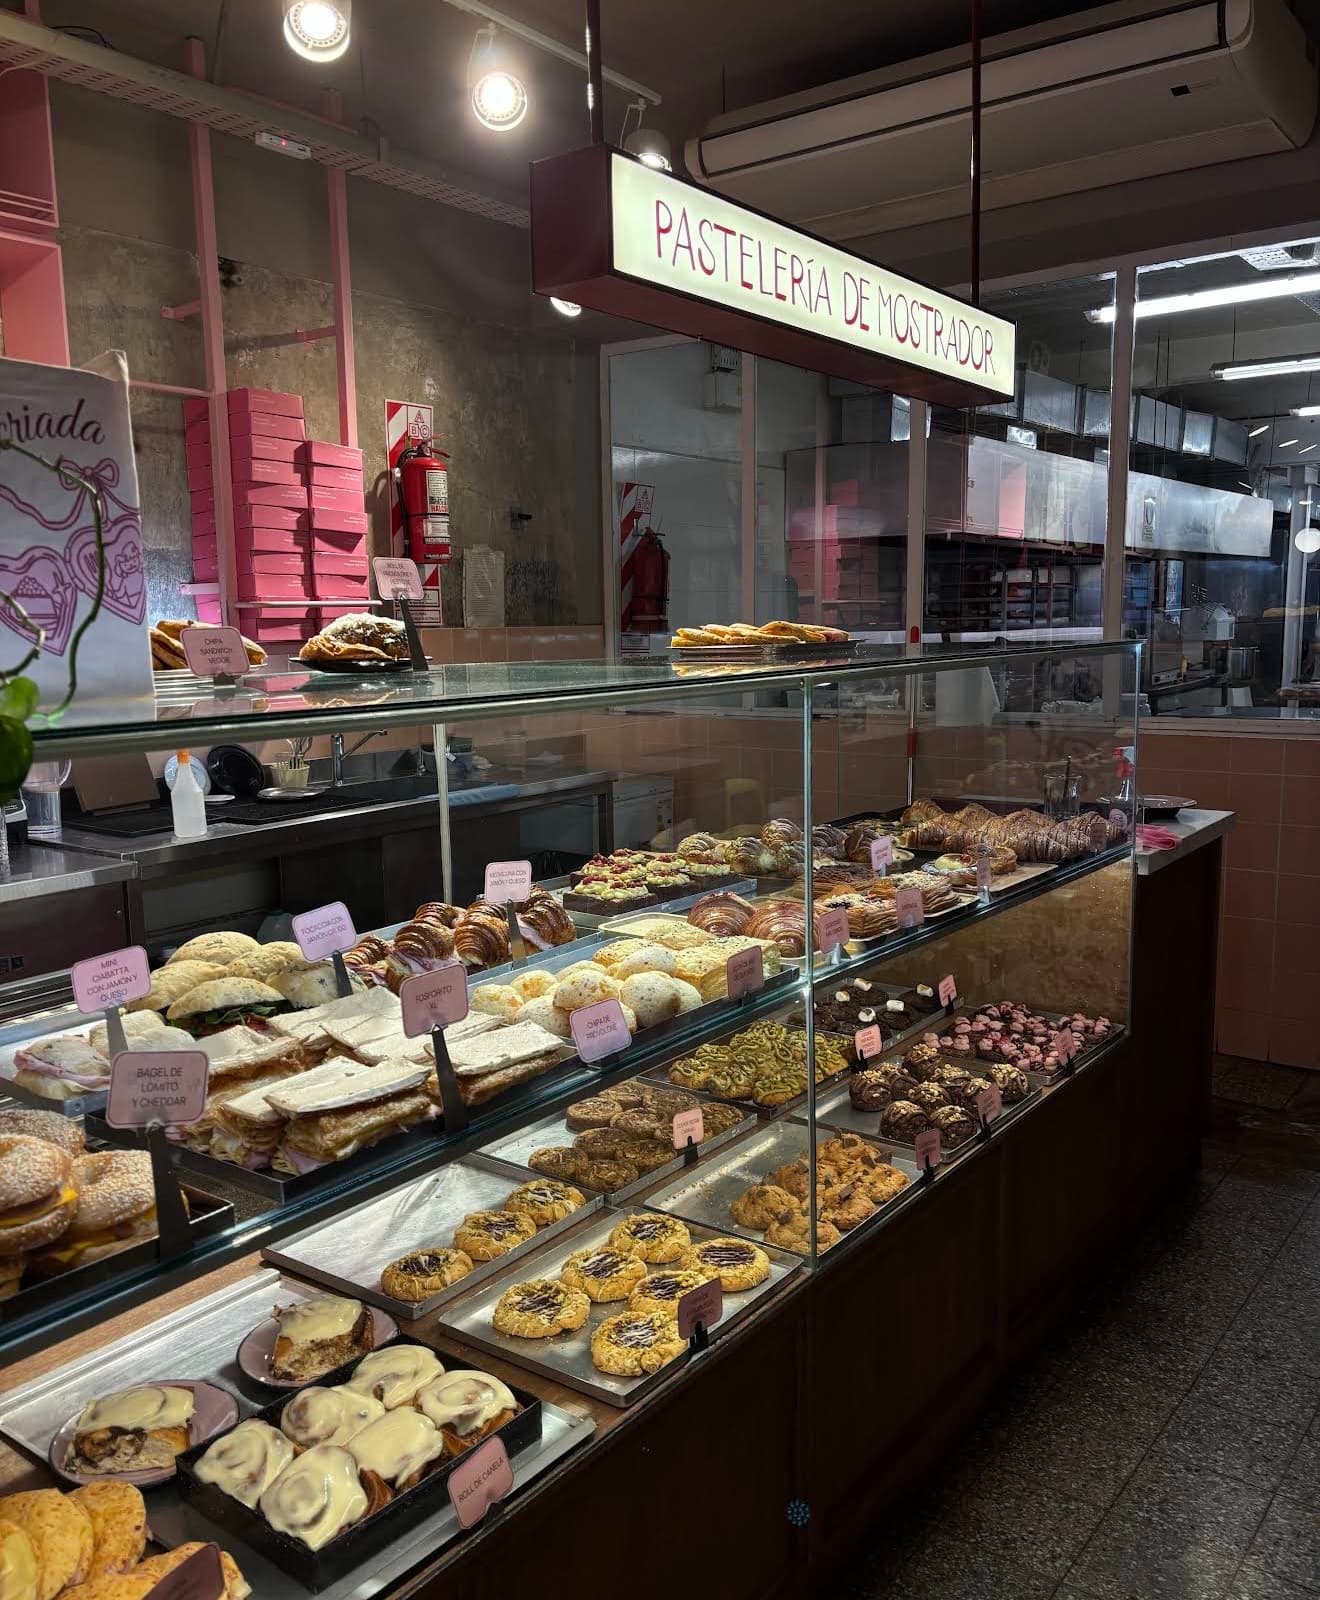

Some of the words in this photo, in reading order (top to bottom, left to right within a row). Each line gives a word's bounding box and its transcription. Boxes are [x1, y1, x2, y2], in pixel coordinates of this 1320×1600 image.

[655, 199, 832, 316] PASTELERÍA
[843, 271, 870, 332] DE
[878, 285, 996, 375] MOSTRADOR
[101, 958, 118, 970] MINI
[92, 965, 130, 983] CIABATTA
[86, 983, 105, 996] CON
[100, 988, 128, 1002] QUESO
[136, 1066, 169, 1079] BAGEL
[170, 1066, 184, 1078] DE
[140, 1080, 180, 1094] LOMITO
[131, 1096, 139, 1108] Y
[139, 1095, 187, 1109] CHEDDAR
[458, 1484, 476, 1503] ROLL
[481, 1456, 505, 1480] CANELA
